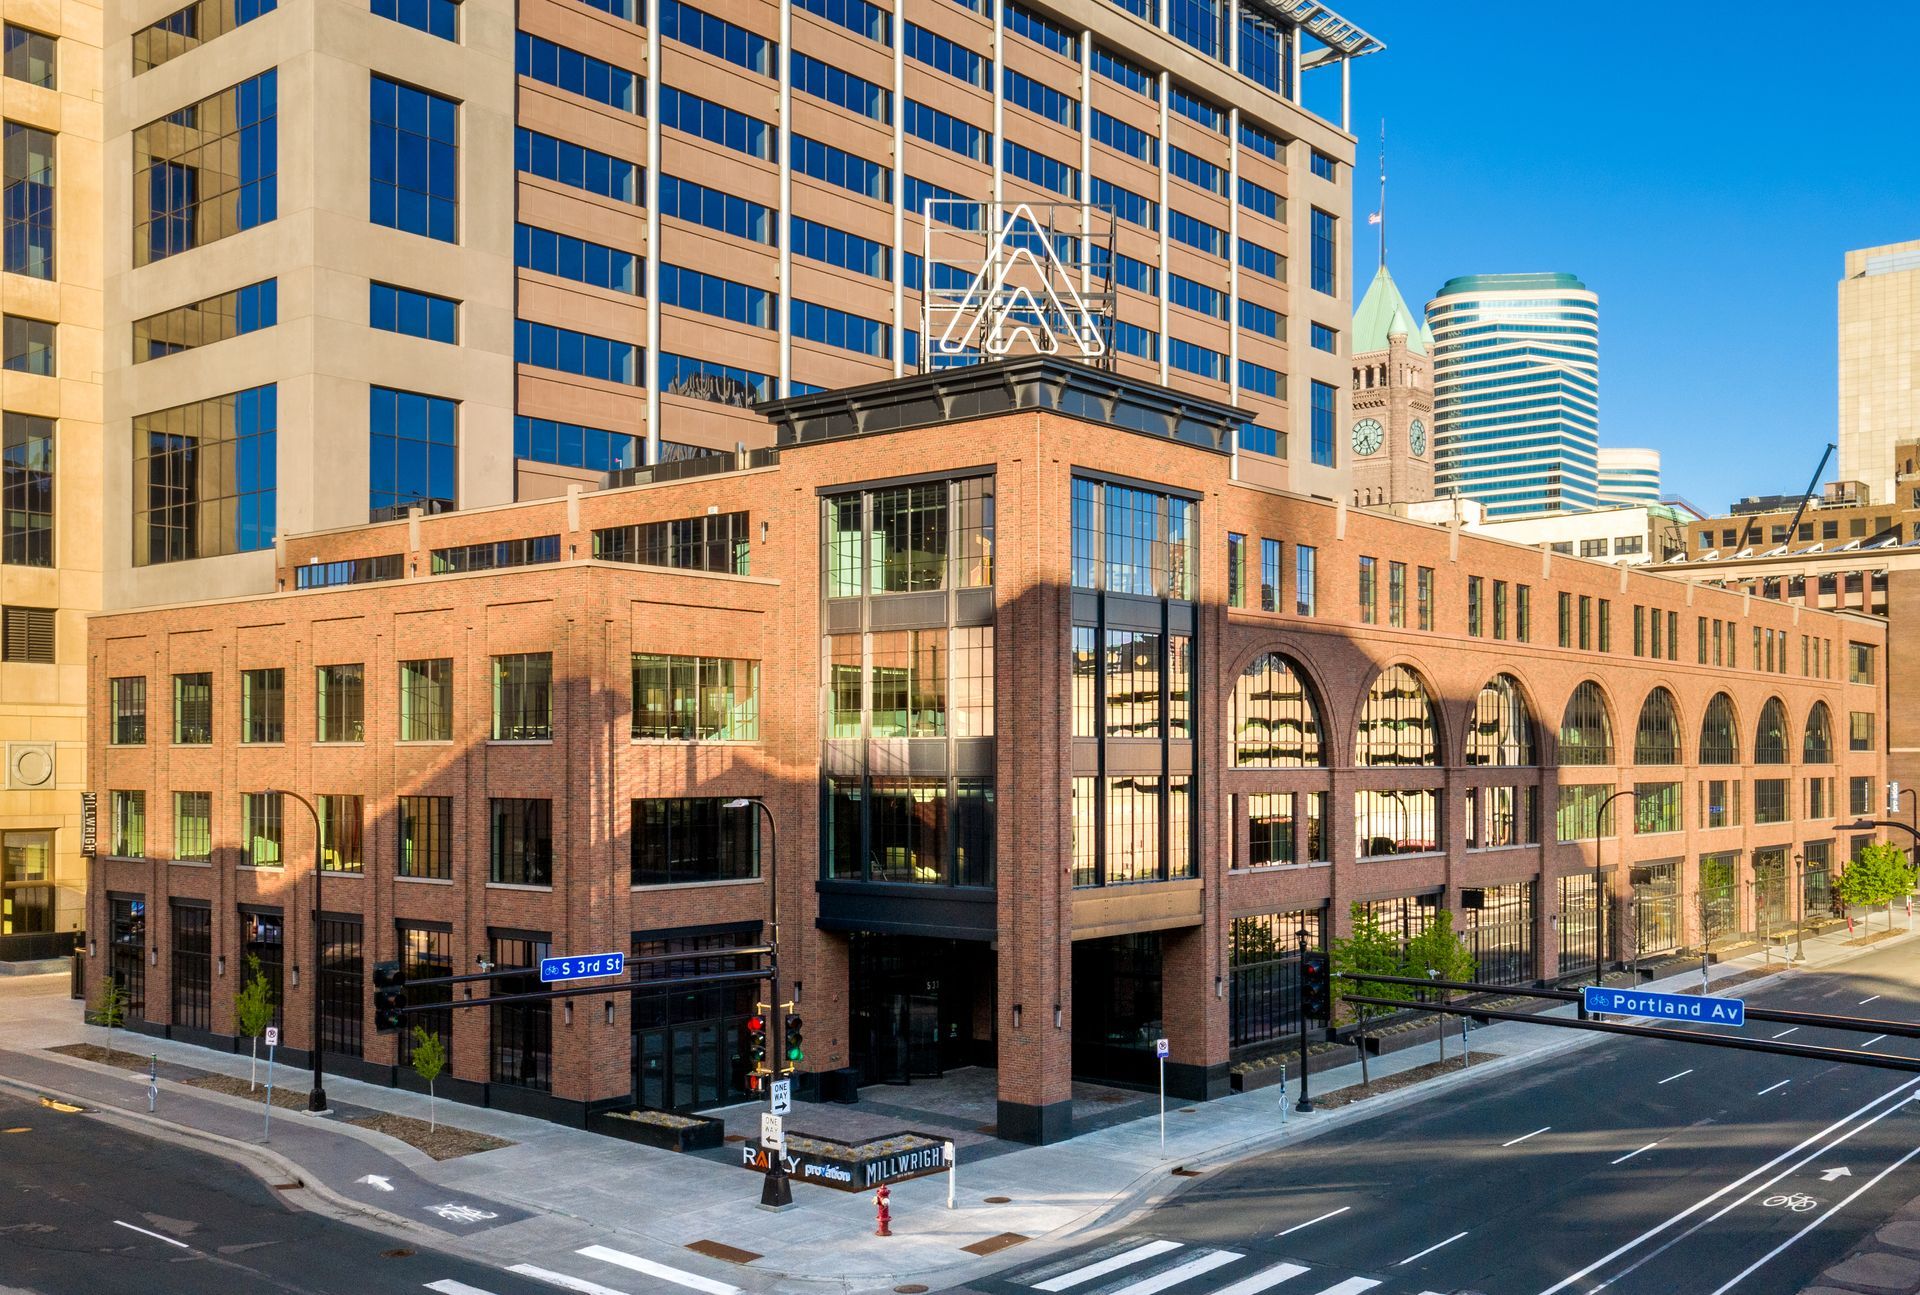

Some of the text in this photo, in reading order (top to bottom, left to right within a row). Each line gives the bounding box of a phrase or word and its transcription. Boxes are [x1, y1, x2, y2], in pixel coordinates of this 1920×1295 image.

[84, 793, 95, 857] MILLWRIGHT
[562, 958, 620, 975] S 3rd St
[1613, 995, 1738, 1020] Portland Av
[774, 1083, 788, 1093] ONE
[774, 1092, 788, 1101] WAY
[765, 1117, 778, 1127] ONE
[866, 1146, 945, 1187] MILLWRIGHT
